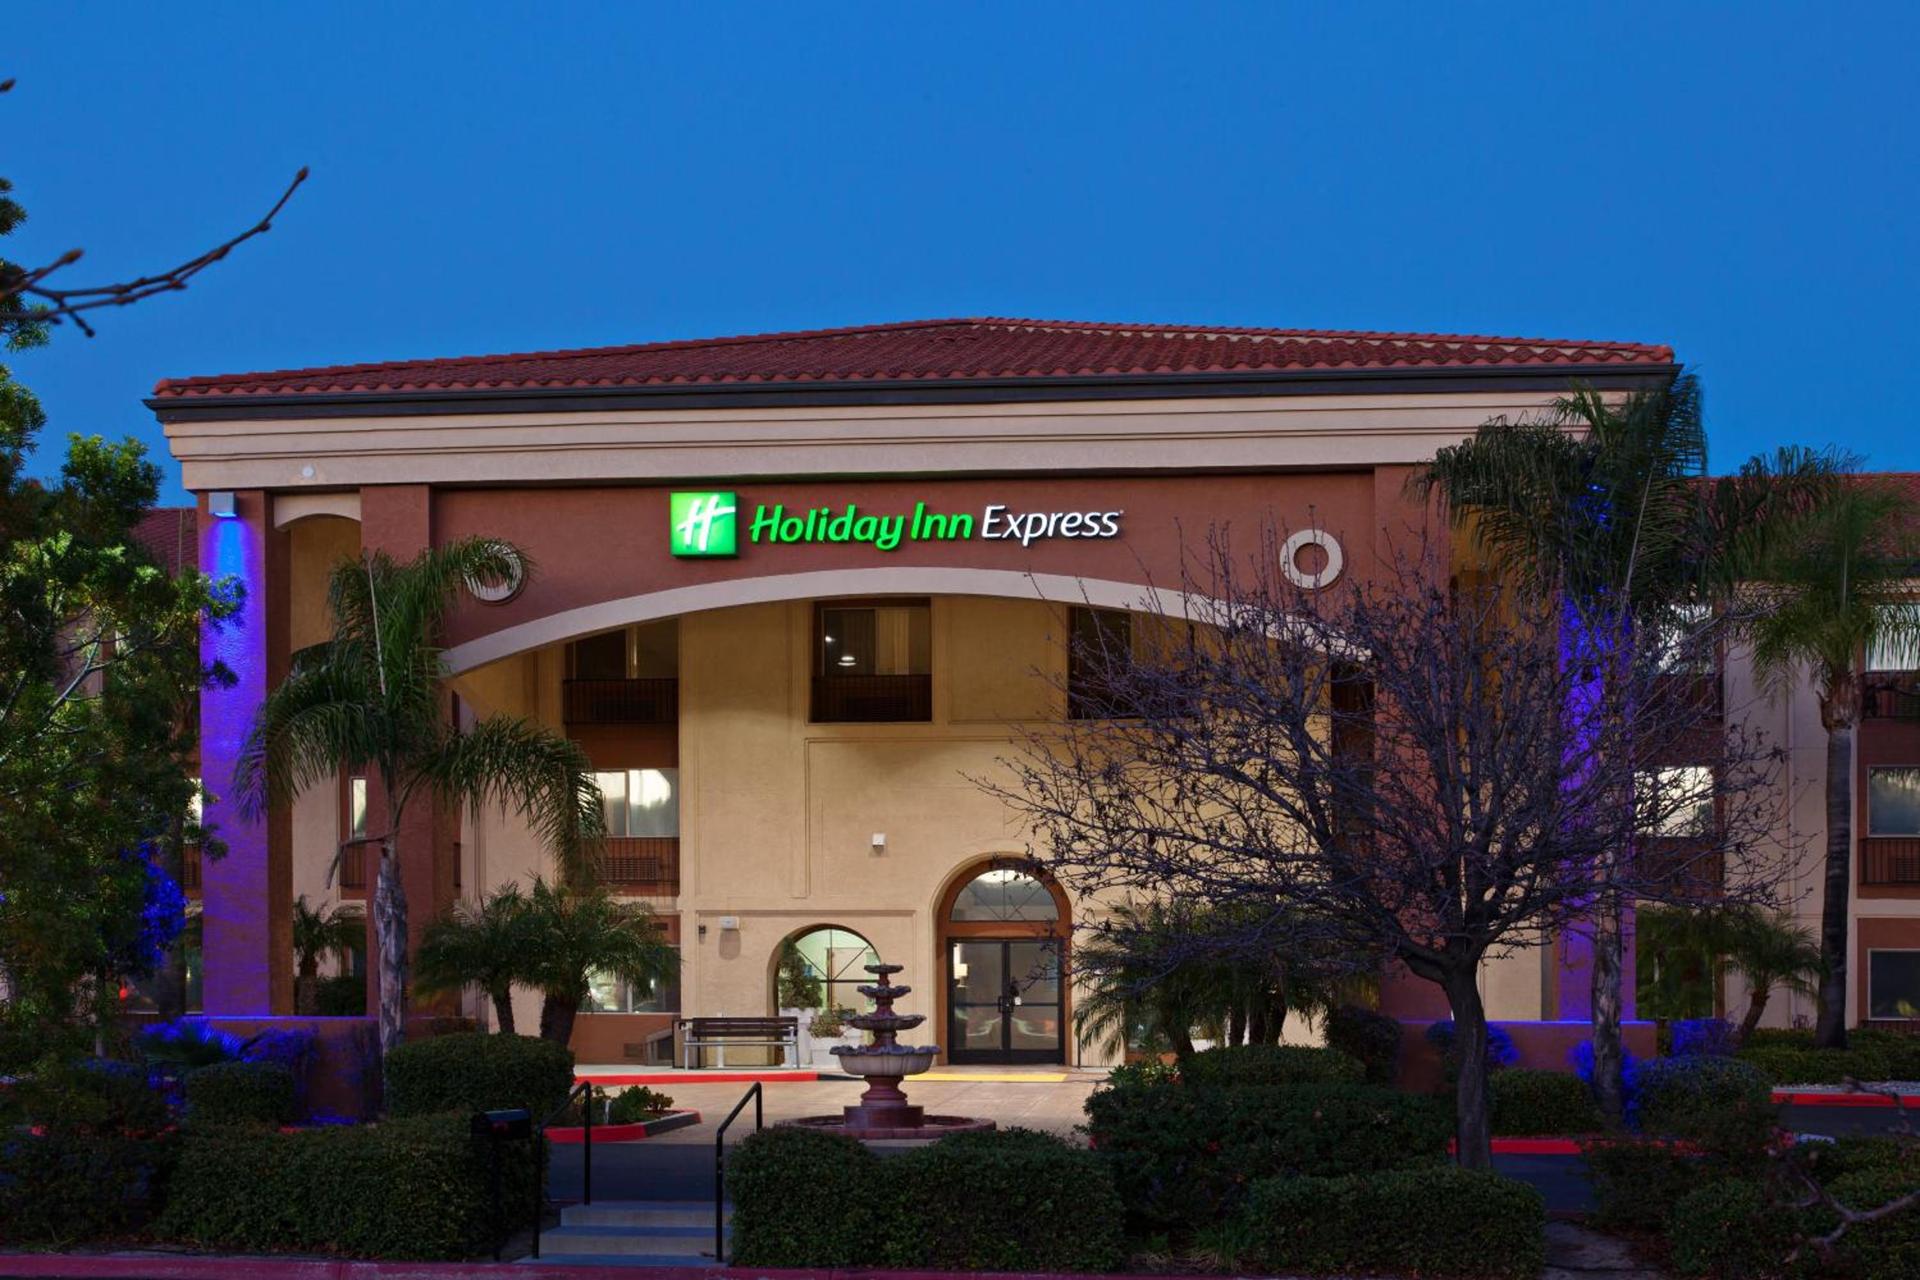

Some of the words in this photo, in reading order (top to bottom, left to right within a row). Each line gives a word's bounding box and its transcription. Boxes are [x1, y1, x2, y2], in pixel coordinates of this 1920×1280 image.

[748, 503, 905, 551] Holiday
[910, 501, 974, 542] Inn
[980, 504, 1121, 547] Express
